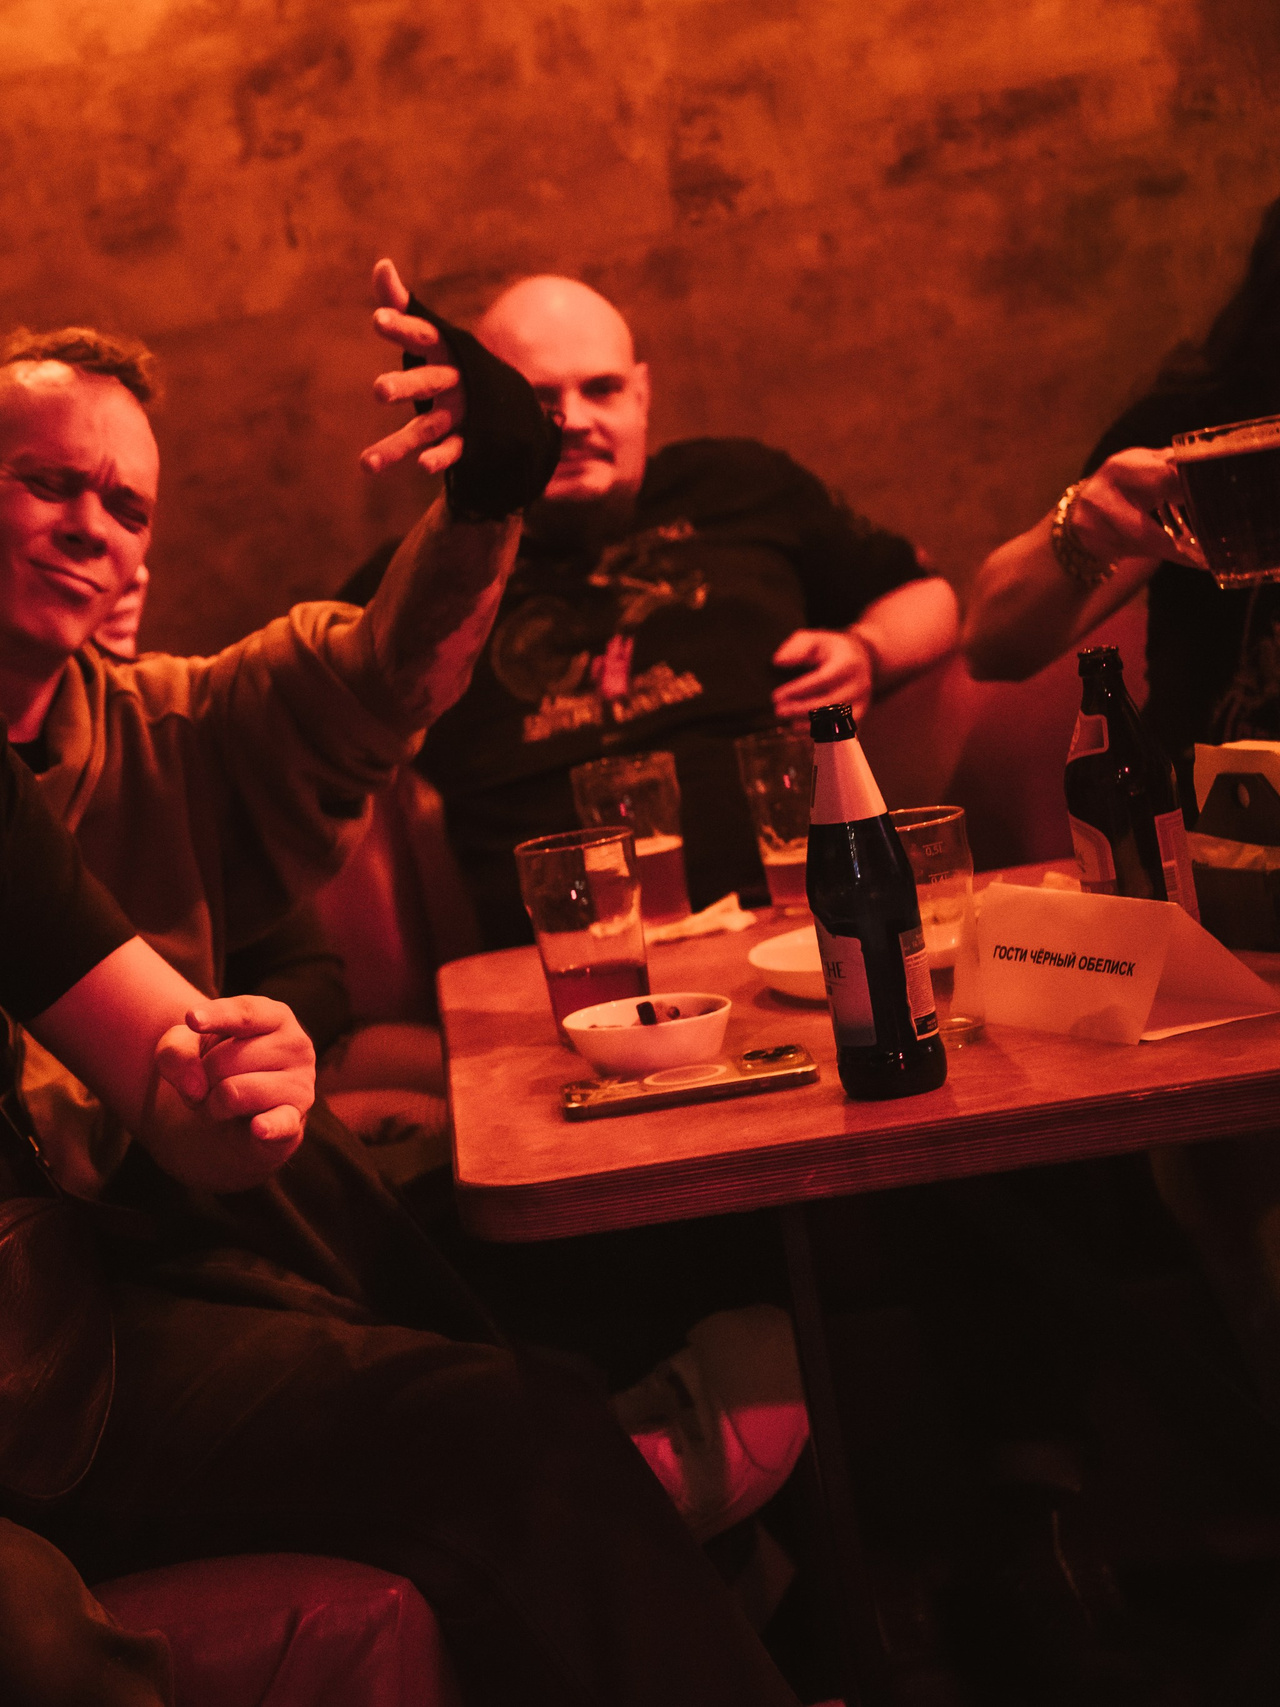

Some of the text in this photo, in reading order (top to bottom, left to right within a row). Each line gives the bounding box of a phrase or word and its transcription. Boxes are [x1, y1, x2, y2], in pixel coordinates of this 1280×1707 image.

[992, 944, 1136, 977] ГОСТИ ЧЁРНЫЙ ОБЕЛИСК
